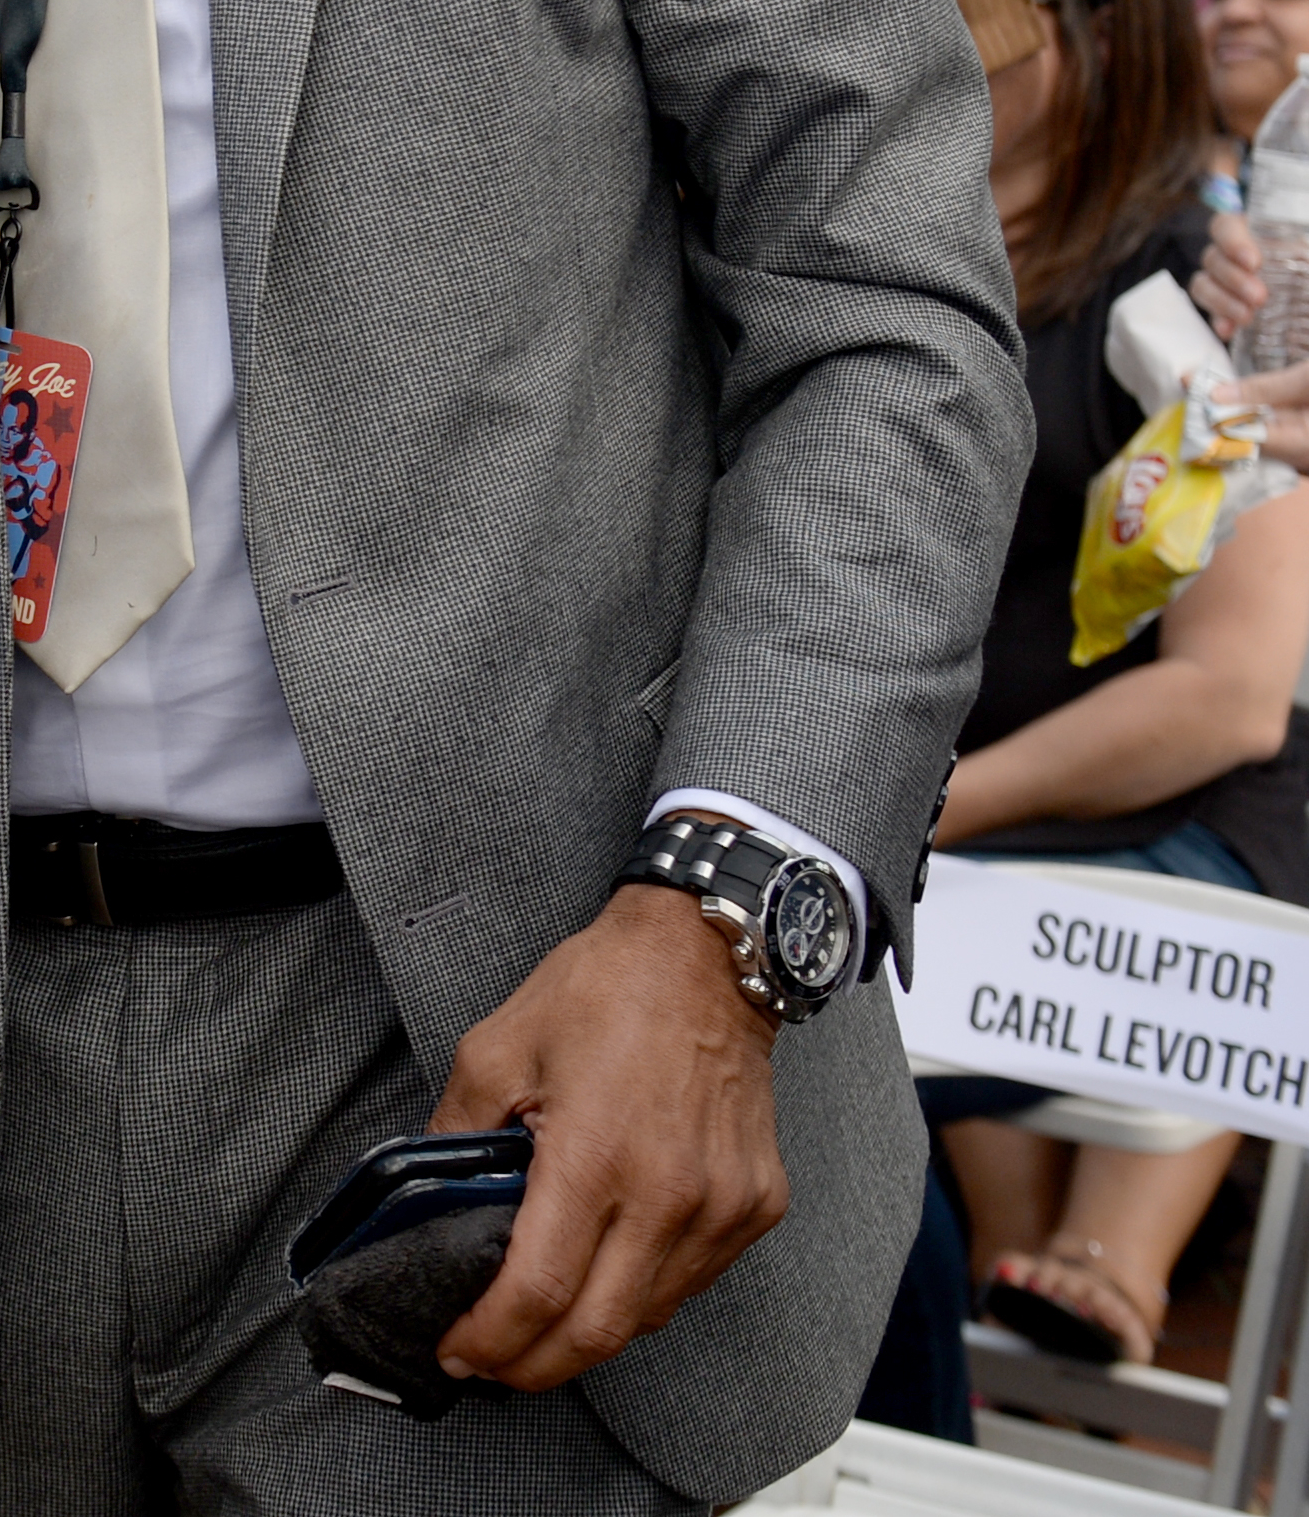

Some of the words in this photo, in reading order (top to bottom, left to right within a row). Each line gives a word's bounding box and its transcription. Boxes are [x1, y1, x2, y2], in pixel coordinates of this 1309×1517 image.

[776, 871, 791, 890] 35
[1032, 911, 1274, 1009] SCULPTOR
[969, 984, 1082, 1056] CARL
[1097, 1014, 1309, 1108] LEVOTCH
